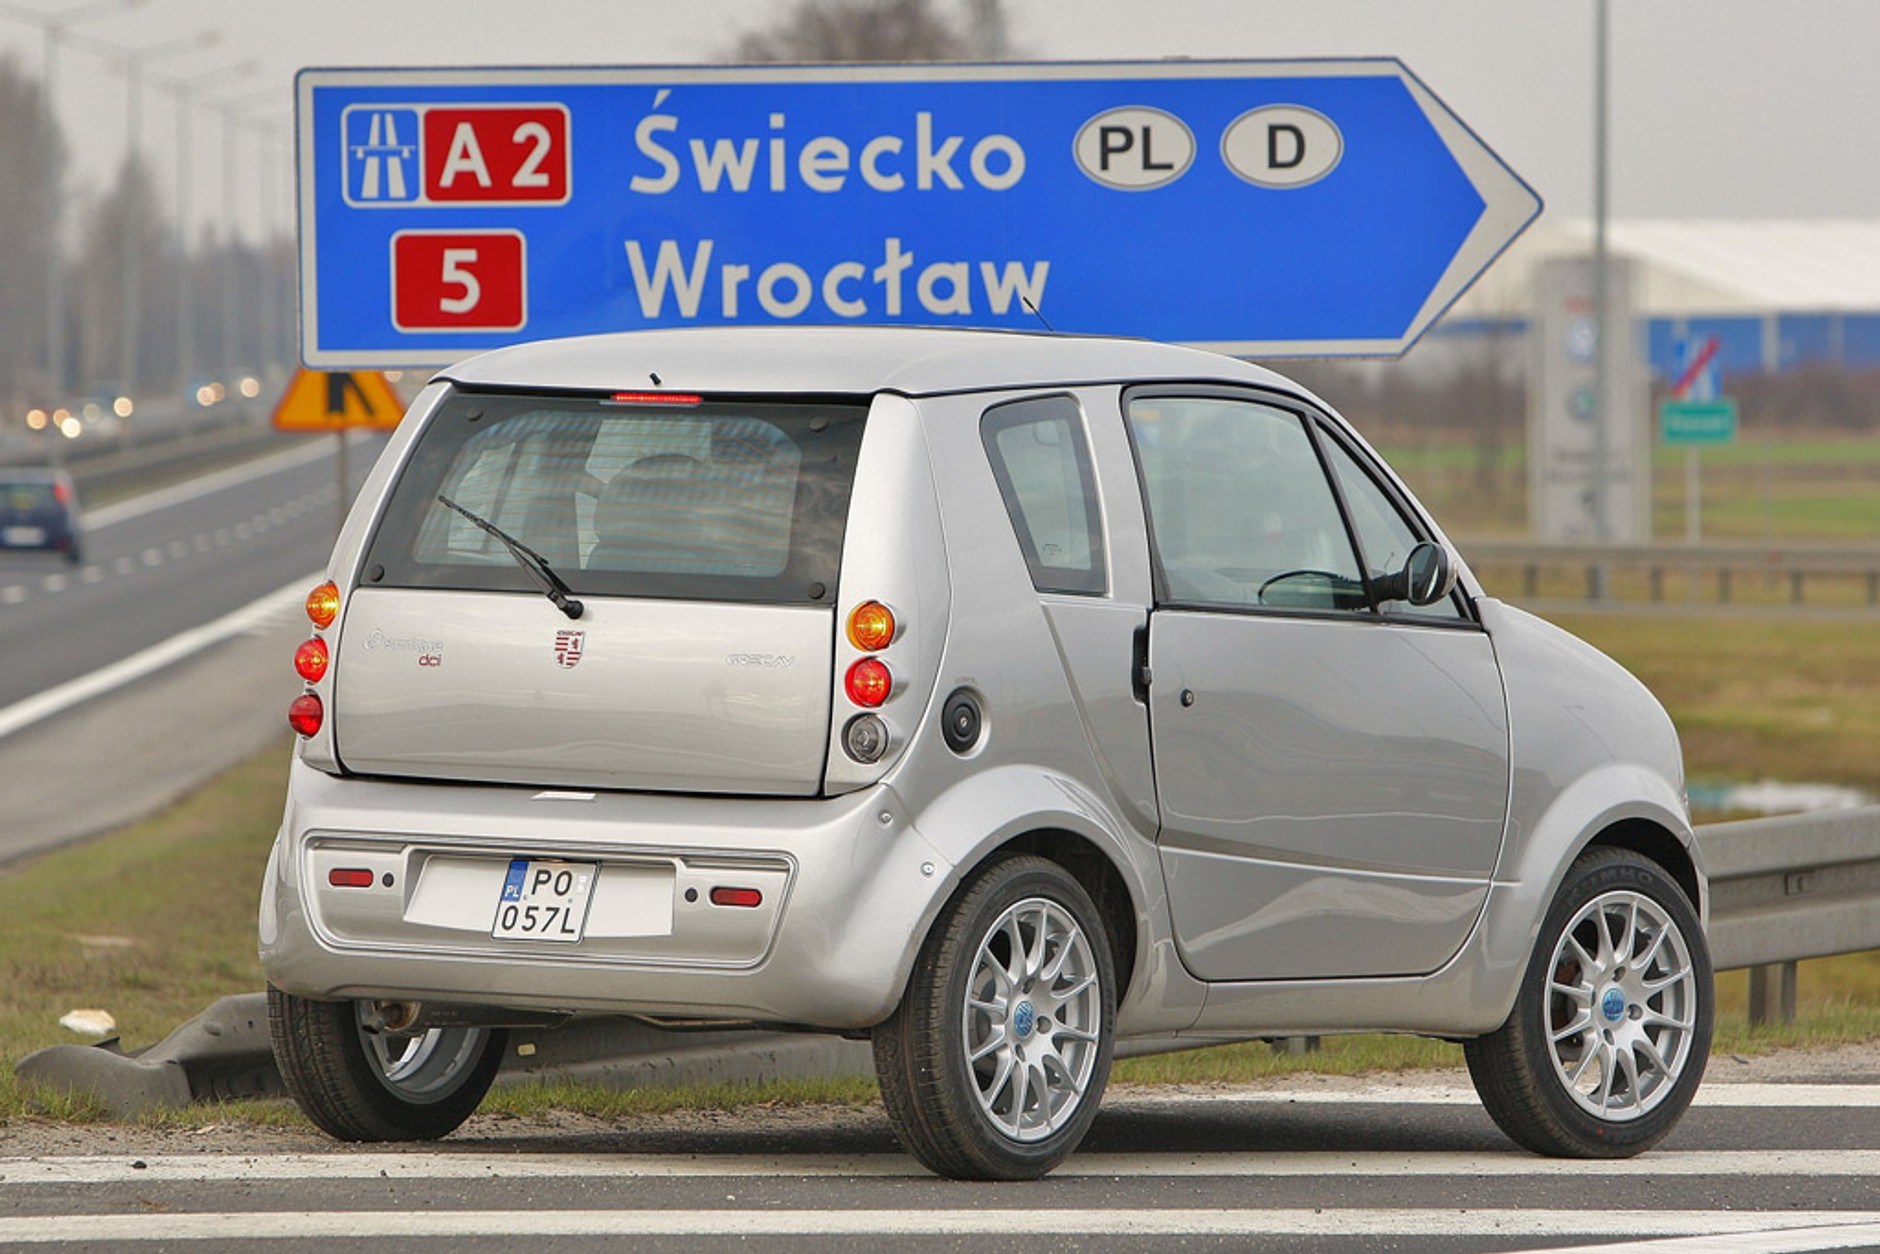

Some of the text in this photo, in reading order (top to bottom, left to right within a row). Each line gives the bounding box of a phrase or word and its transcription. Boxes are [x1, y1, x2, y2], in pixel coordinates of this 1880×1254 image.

[629, 88, 1026, 194] Świecko
[1099, 125, 1175, 171] PL
[1266, 123, 1307, 169] D
[439, 248, 481, 314] 5
[624, 237, 1050, 318] Wrocław
[504, 884, 520, 898] PL
[530, 868, 573, 897] PO
[501, 904, 575, 934] 057L
